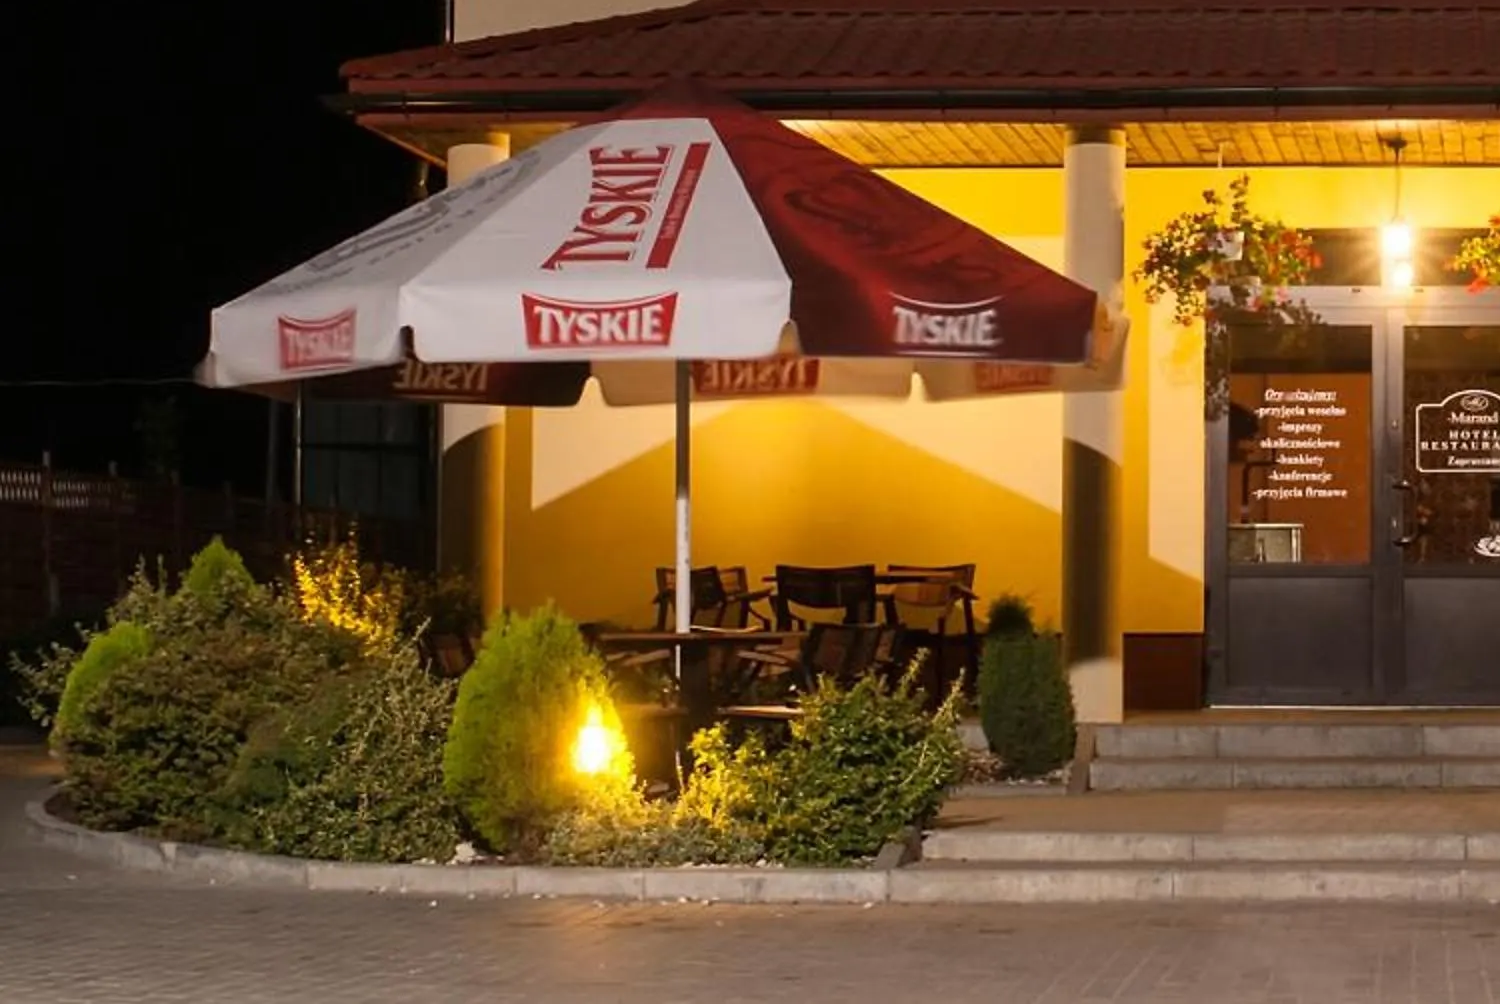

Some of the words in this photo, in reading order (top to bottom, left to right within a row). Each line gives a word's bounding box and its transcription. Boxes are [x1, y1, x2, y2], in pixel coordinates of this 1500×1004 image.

[541, 146, 671, 270] TYSKIE
[534, 304, 663, 344] TYSKIE
[892, 305, 999, 346] TYSKIE
[1449, 430, 1500, 440] HOTEL
